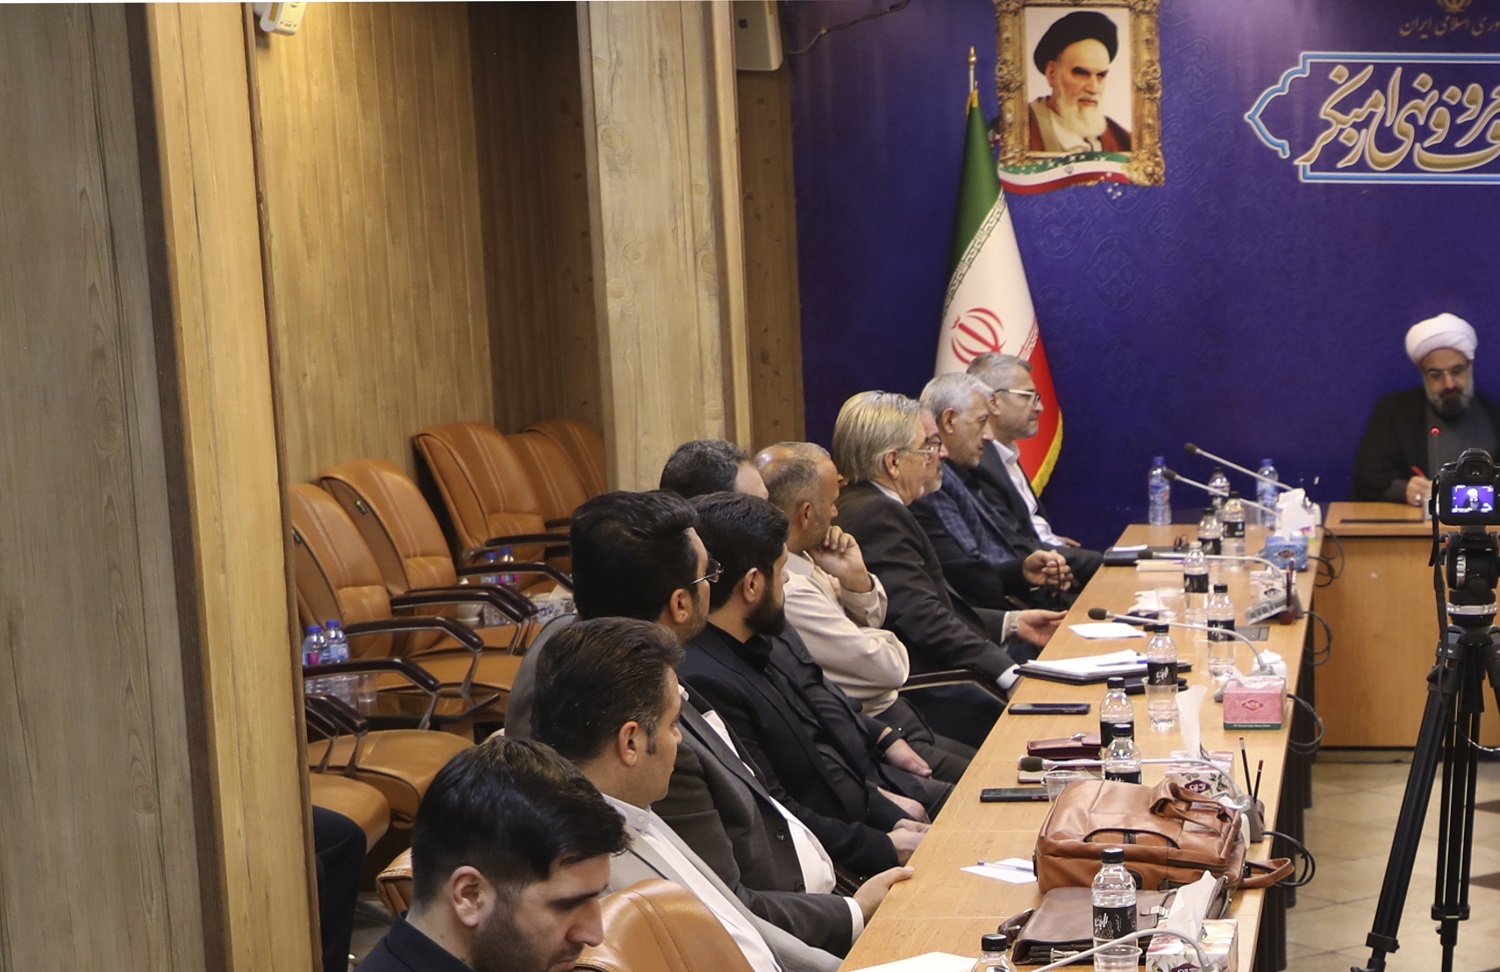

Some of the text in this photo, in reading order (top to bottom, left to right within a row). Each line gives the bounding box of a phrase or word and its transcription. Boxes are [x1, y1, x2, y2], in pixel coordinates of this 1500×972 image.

[1399, 17, 1433, 39] ایران
[1434, 15, 1470, 36] اسلامی
[1293, 64, 1386, 165] منکر
